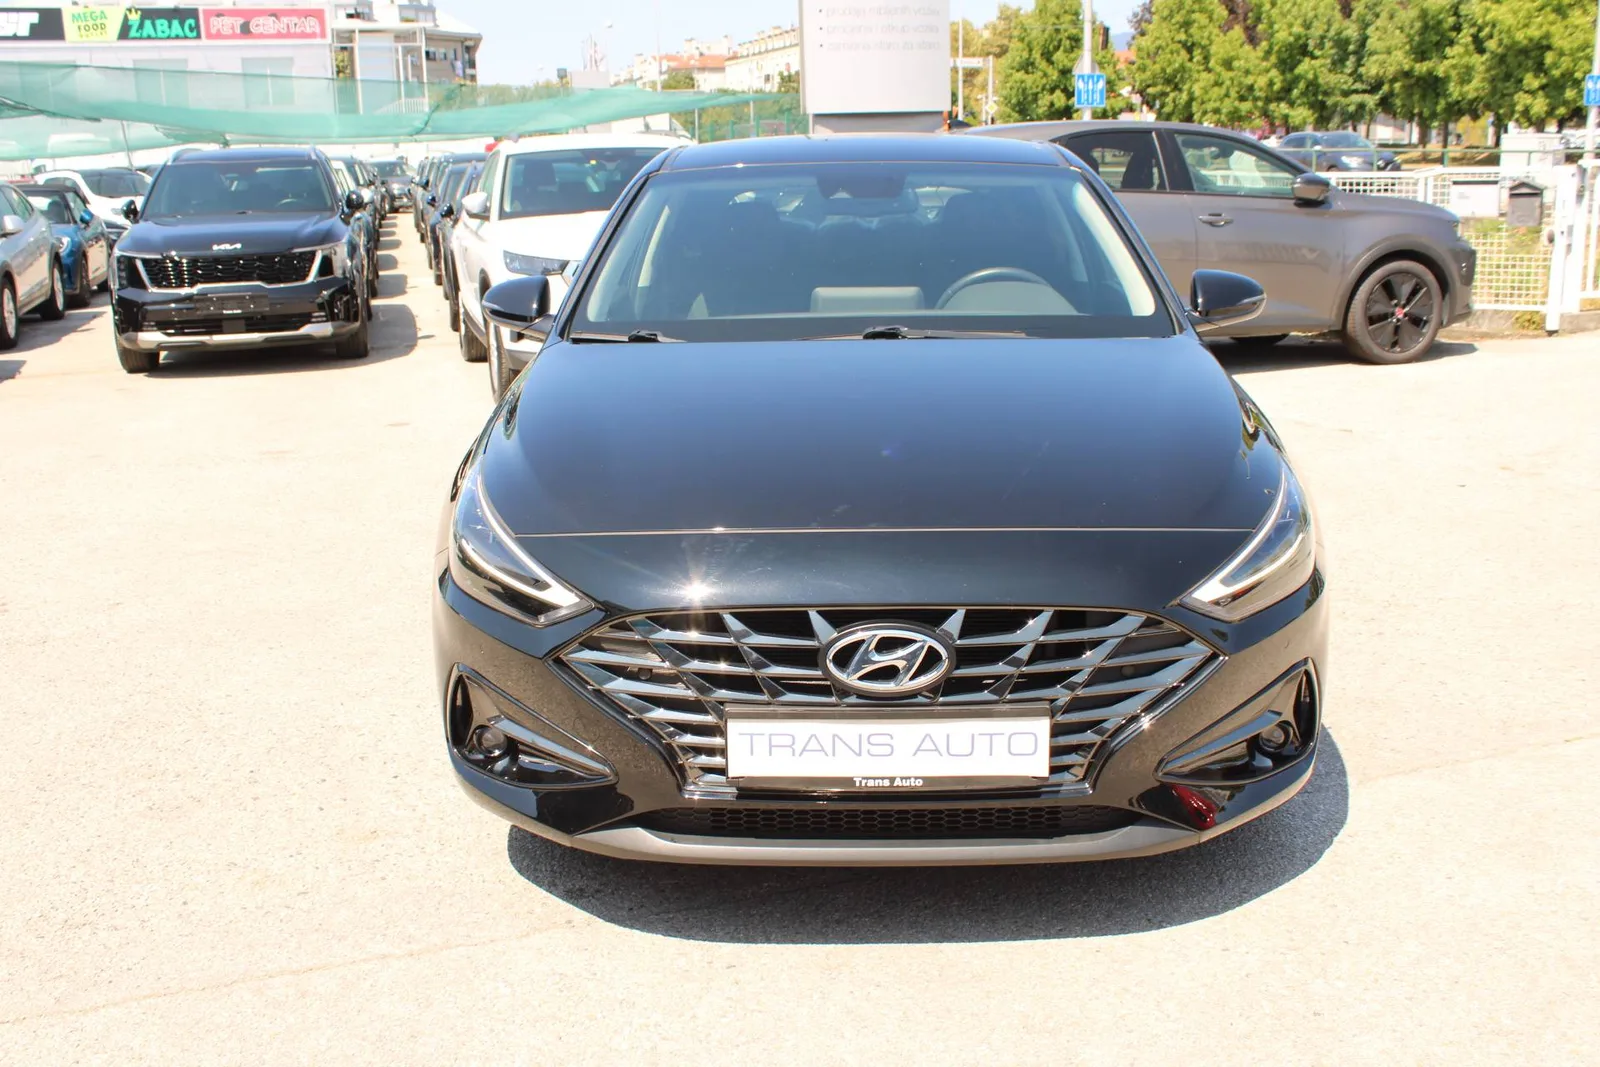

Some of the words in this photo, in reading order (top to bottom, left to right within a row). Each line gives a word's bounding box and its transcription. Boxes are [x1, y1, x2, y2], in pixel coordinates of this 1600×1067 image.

[71, 10, 108, 24] MEGA
[77, 23, 107, 33] FOOD
[209, 17, 242, 35] PET
[249, 16, 320, 35] CENTAR
[738, 732, 895, 757] TRANS
[912, 731, 1039, 757] AUTO
[853, 776, 890, 787] Trans
[893, 776, 924, 787] Auto
